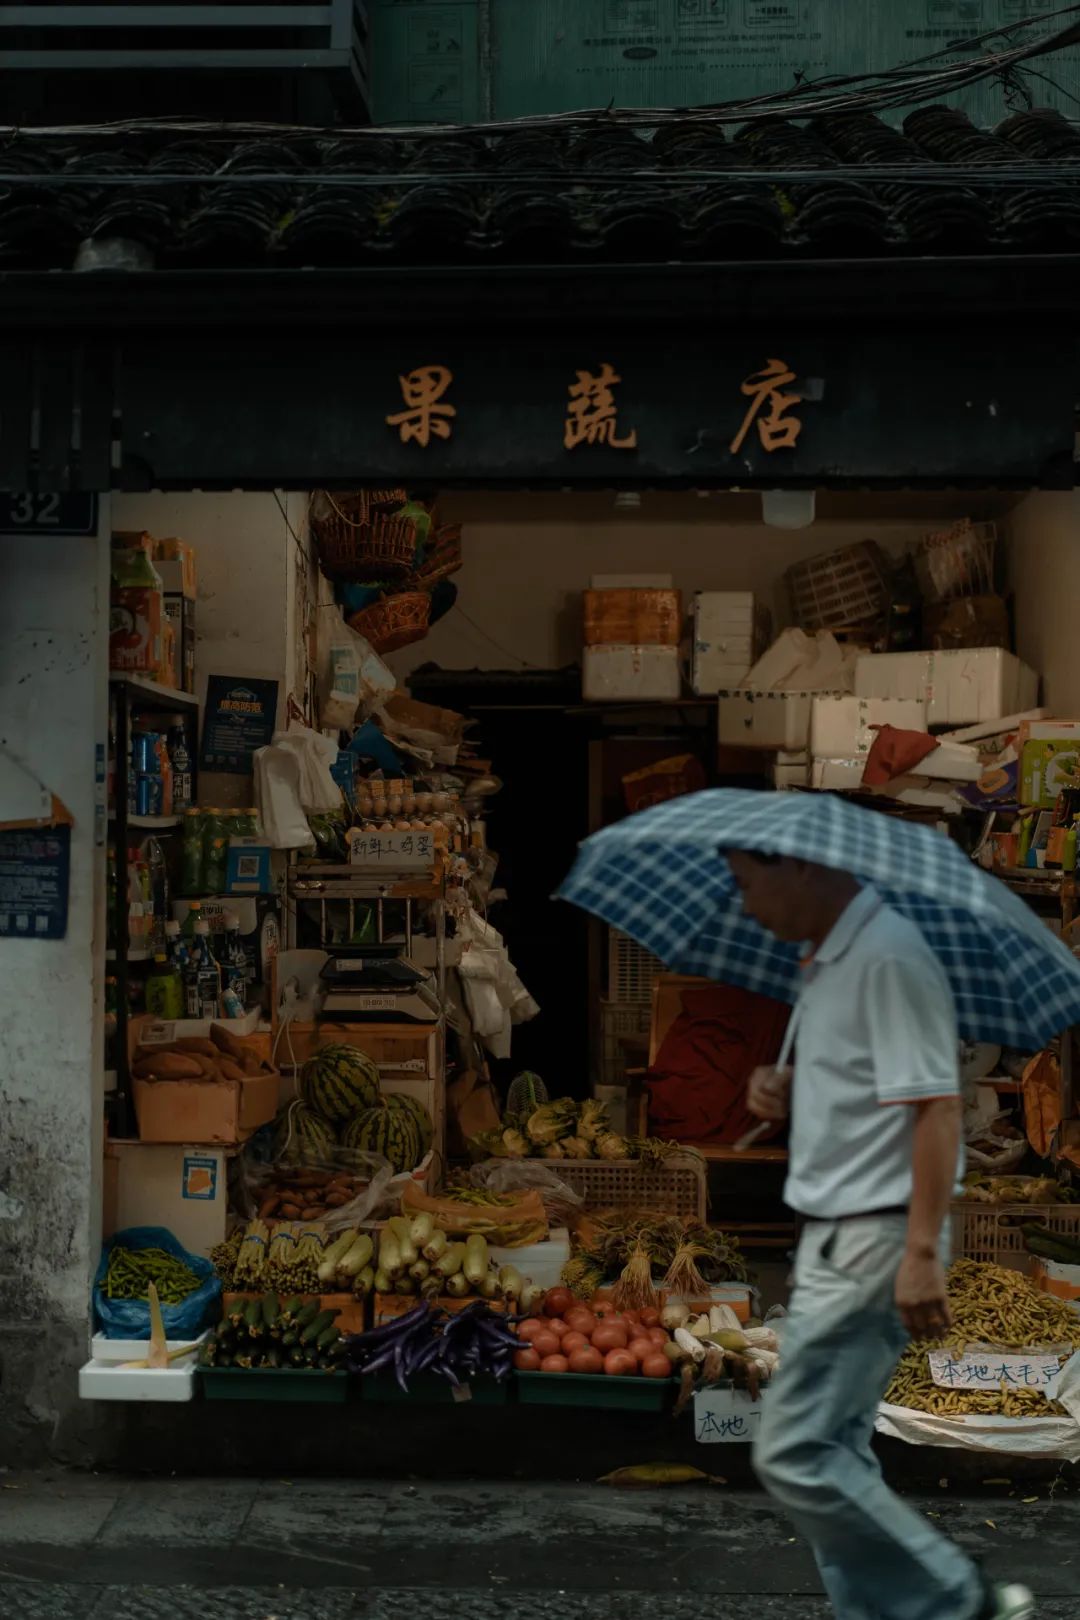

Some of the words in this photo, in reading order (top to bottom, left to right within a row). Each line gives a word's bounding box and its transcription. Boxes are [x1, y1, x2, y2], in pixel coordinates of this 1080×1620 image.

[383, 357, 802, 455] 果蔬店
[10, 490, 60, 524] 32
[352, 835, 433, 861] 新鲜土鸡蛋
[697, 1410, 761, 1440] 本地
